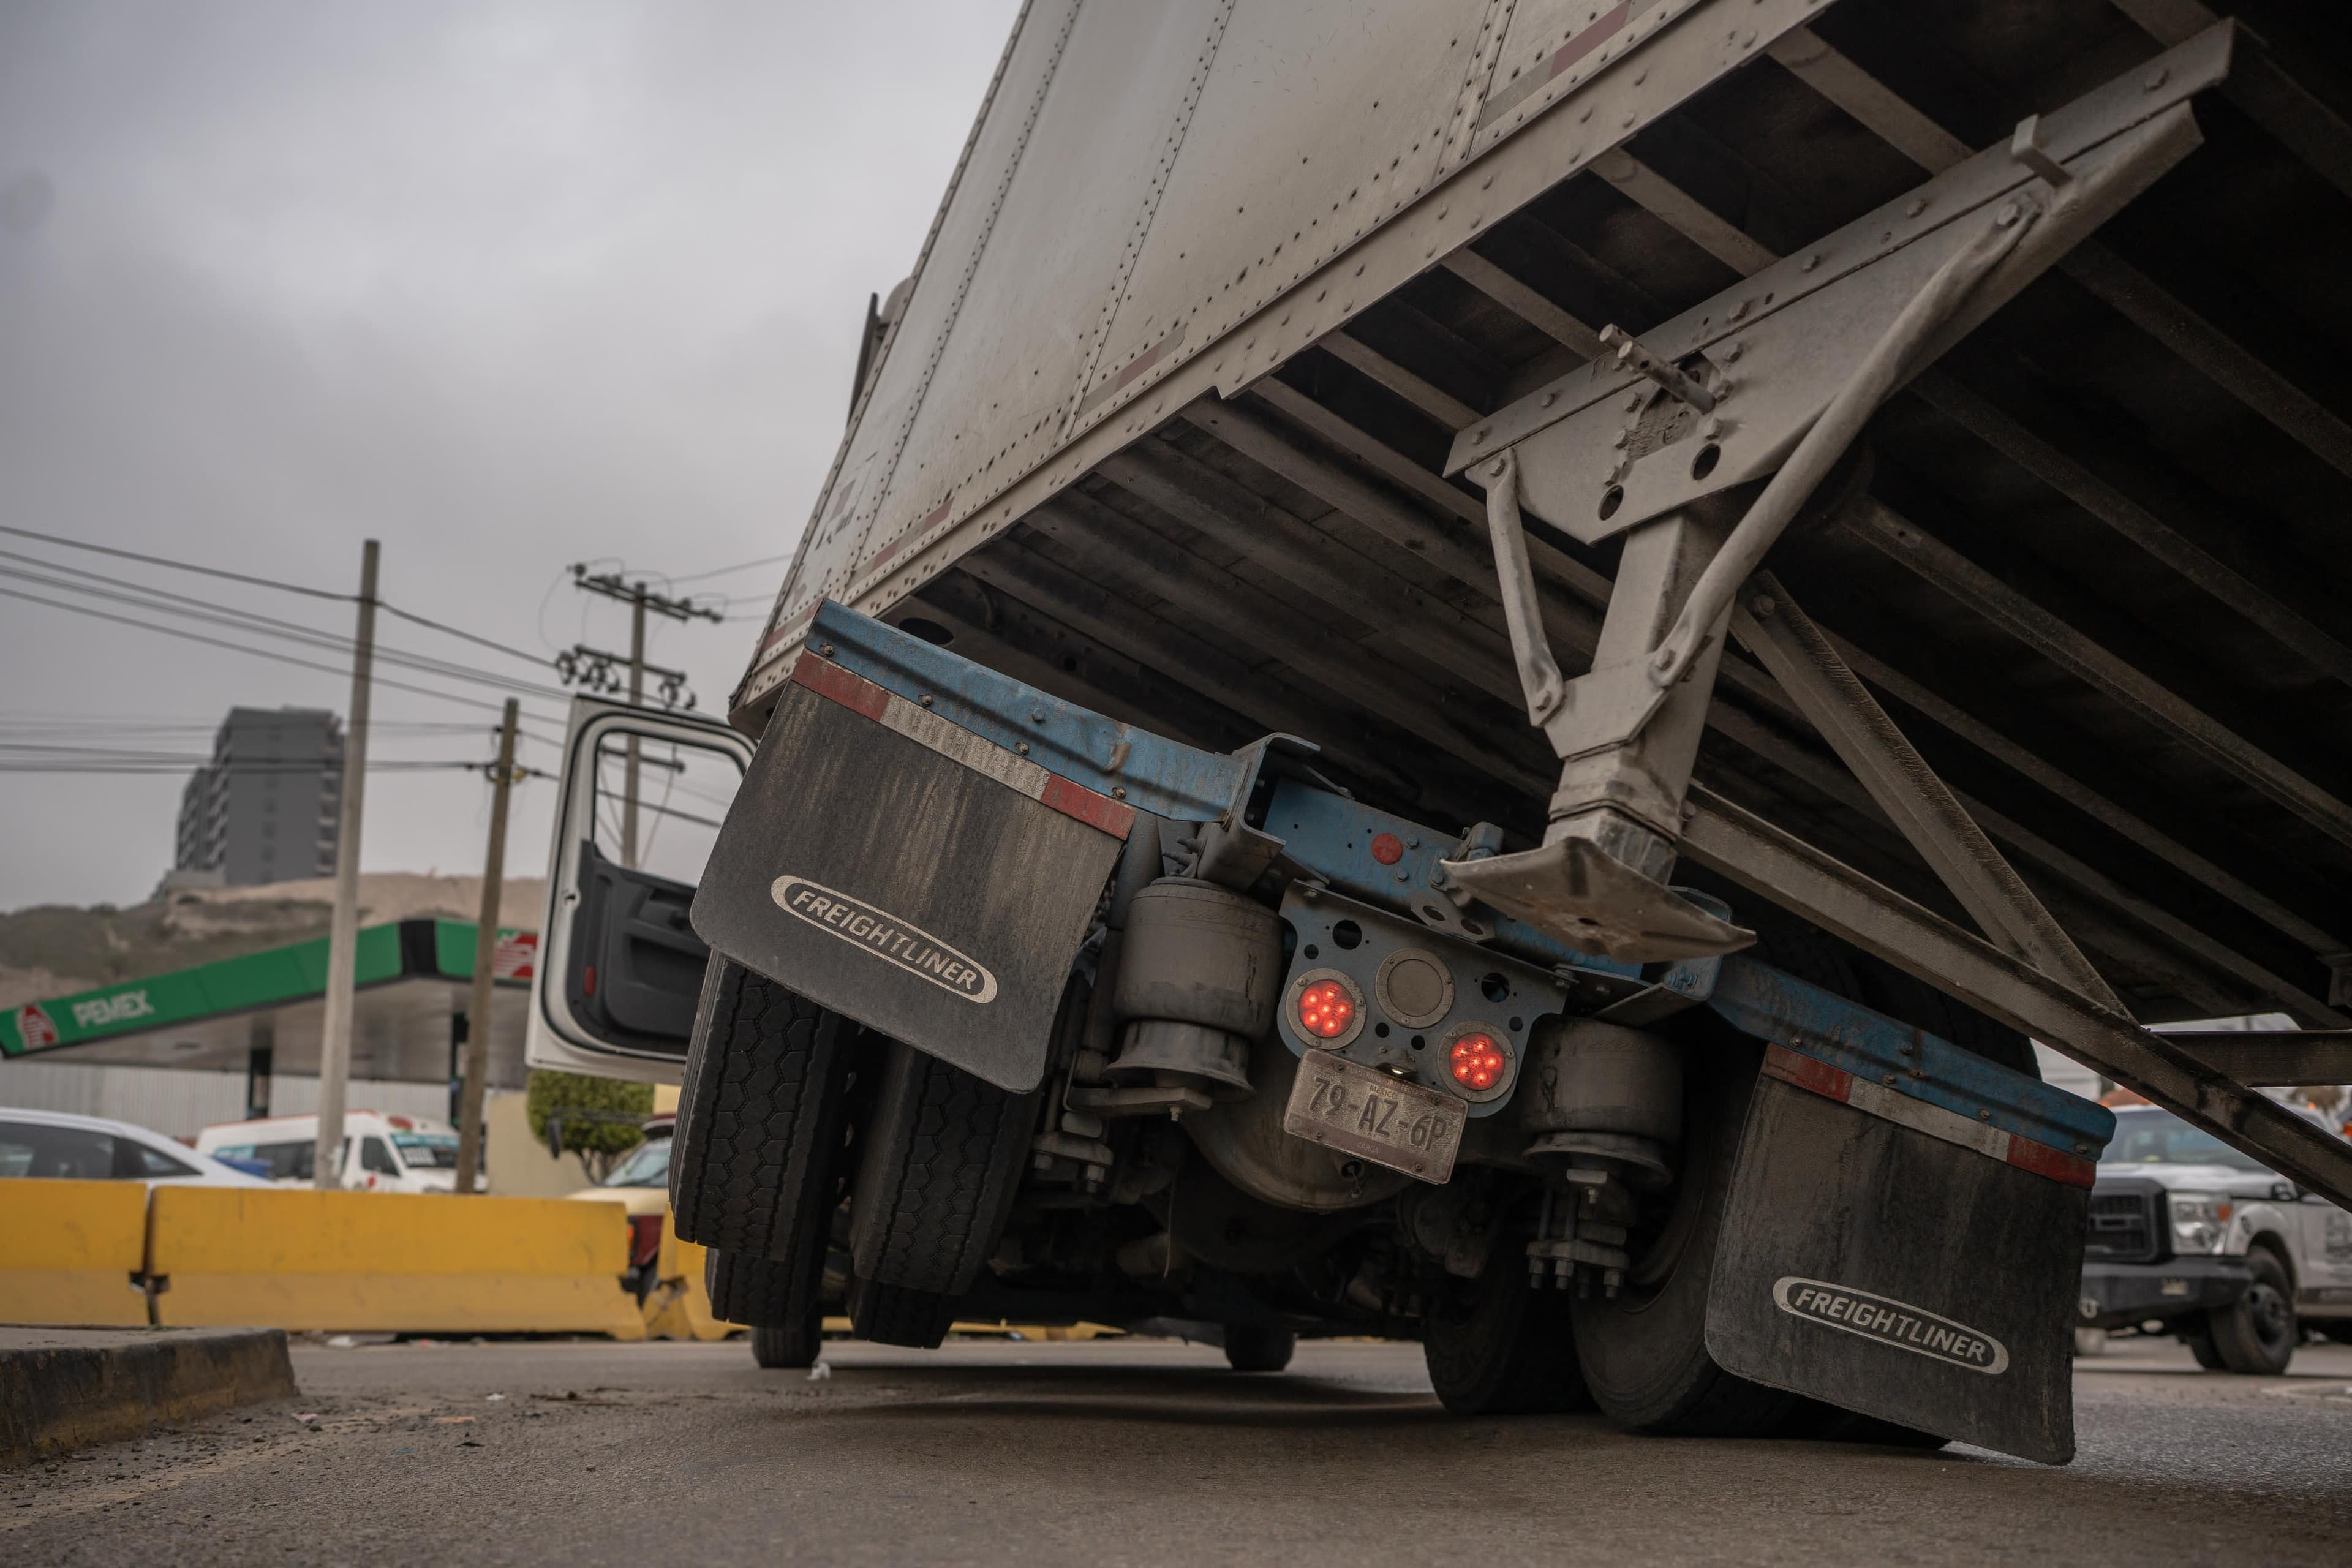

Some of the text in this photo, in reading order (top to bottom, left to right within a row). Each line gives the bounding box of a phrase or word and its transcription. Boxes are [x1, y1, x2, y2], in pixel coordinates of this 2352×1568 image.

[793, 890, 978, 990] FREIGHTLINER
[72, 989, 154, 1028] PEMEX
[1310, 1077, 1447, 1152] 79-AZ-6P
[1795, 1289, 1986, 1362] FREIGHTLINER
